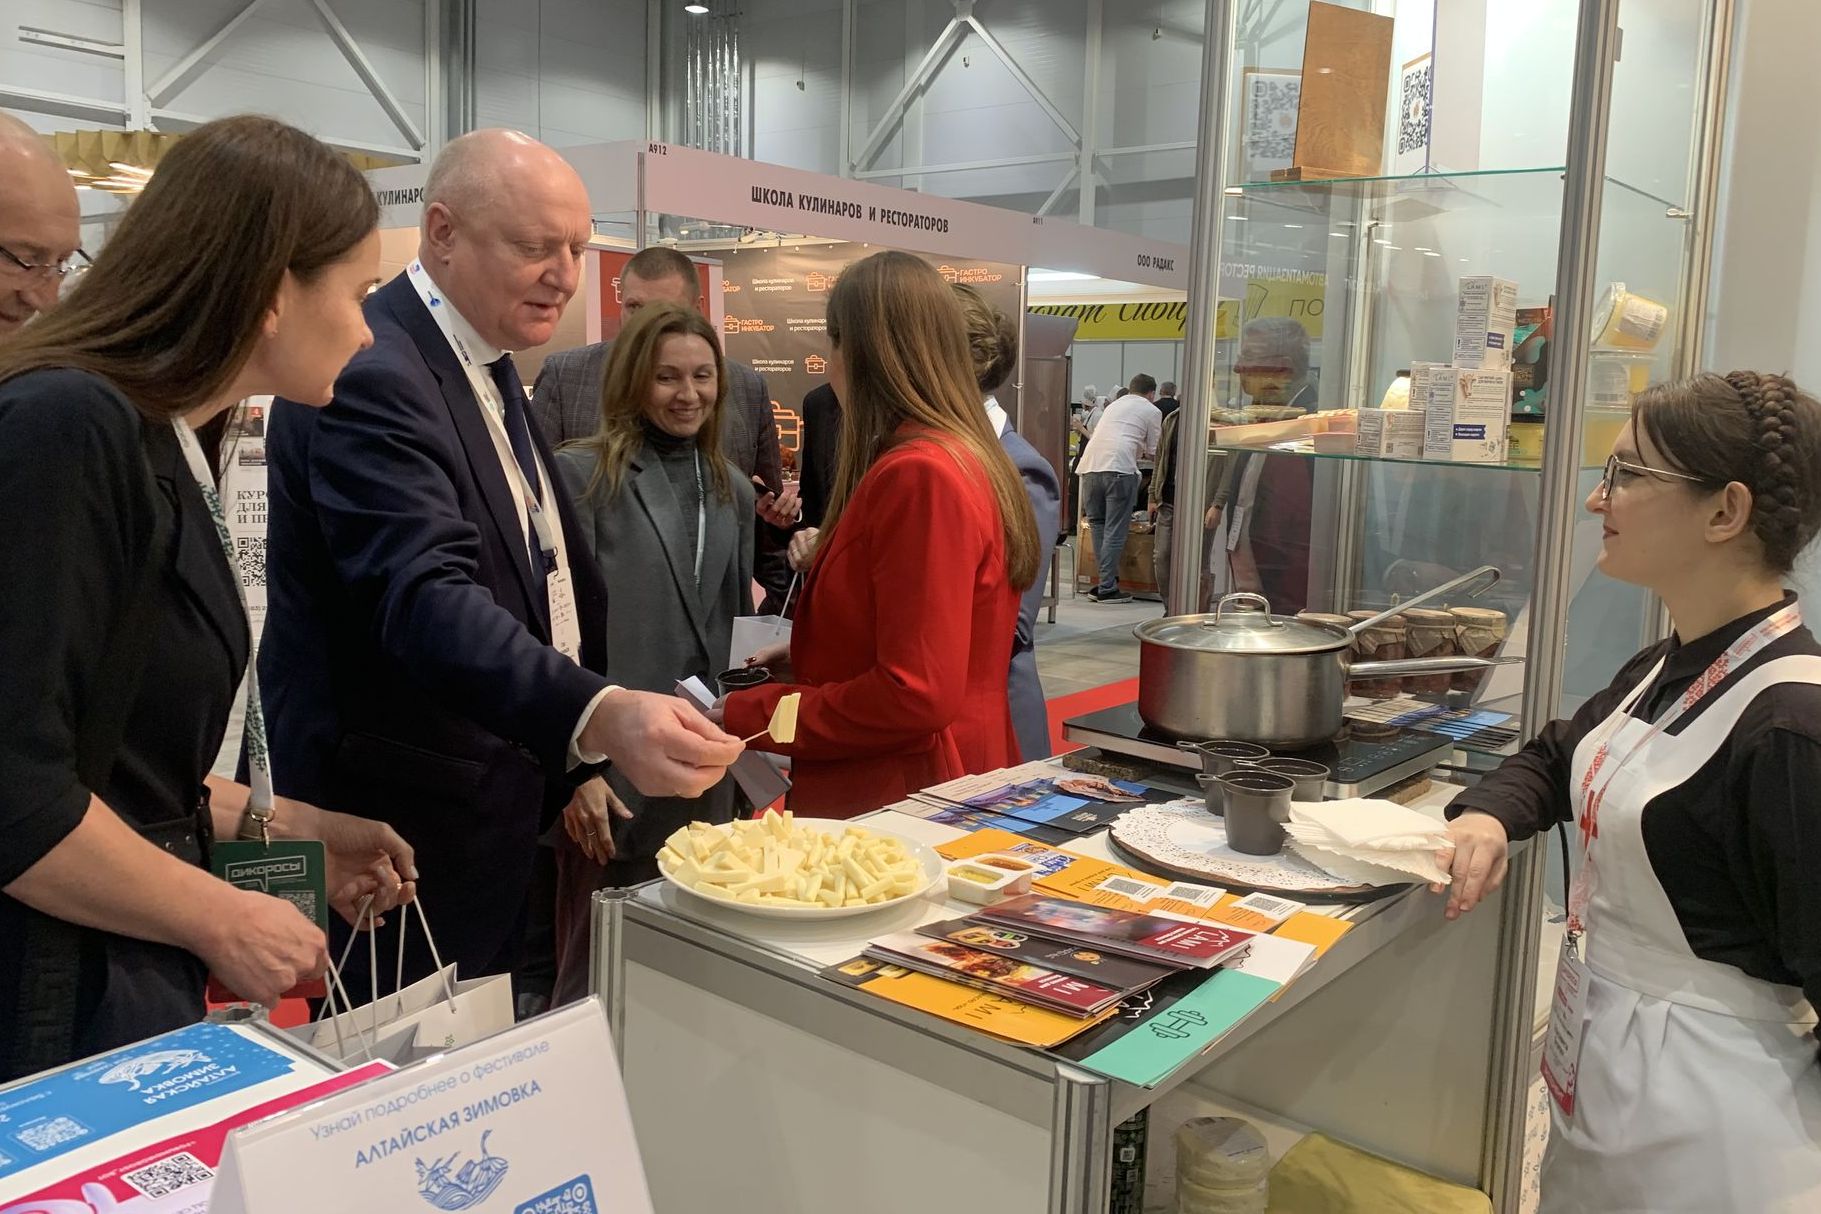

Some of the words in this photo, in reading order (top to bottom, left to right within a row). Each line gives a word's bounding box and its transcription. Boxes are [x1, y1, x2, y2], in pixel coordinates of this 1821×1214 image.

[751, 185, 794, 208] ШКОЛА
[799, 194, 862, 219] КУЛИНАРОВ
[869, 206, 876, 221] И
[880, 208, 949, 233] РЕСТОРАТОРОВ
[960, 268, 988, 276] ГАСТРО
[1137, 254, 1151, 267] ООО
[1152, 256, 1174, 271] РАДАКС
[236, 502, 266, 513] ДЛЯ
[237, 490, 268, 500] КУР
[1170, 930, 1219, 949] LAMI
[140, 1063, 220, 1094] ЗИМОВКА
[143, 1065, 237, 1104] АЛТАЙСКАЯ
[310, 1110, 362, 1142] Узнай
[364, 1079, 458, 1123] подробнее
[460, 1071, 471, 1084] о
[473, 1040, 550, 1081] фестивале
[355, 1111, 460, 1168] АЛТАЙСКАЯ
[464, 1079, 542, 1123] ЗИМОВКА
